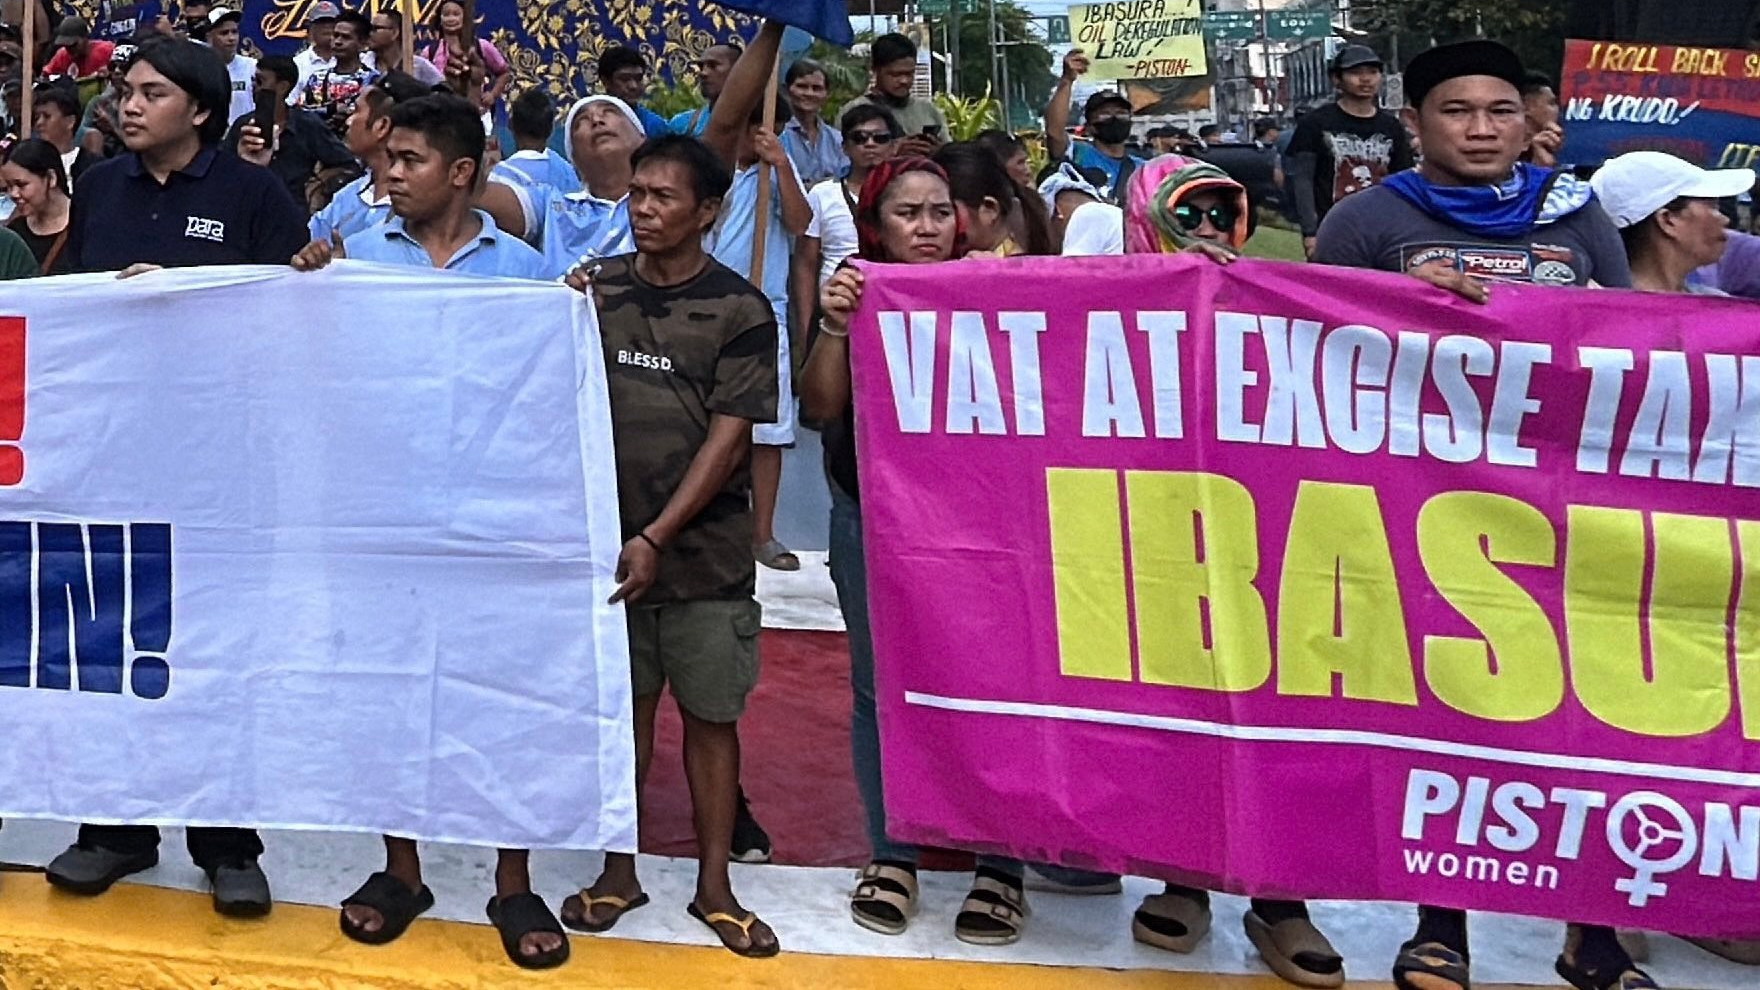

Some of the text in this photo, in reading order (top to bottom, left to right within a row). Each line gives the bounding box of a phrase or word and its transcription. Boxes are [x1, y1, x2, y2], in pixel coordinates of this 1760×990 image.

[1078, 23, 1107, 43] OIL
[1670, 47, 1728, 76] BACK
[1565, 96, 1593, 121] NG
[1469, 256, 1527, 270] Petrol
[876, 309, 1760, 488] VAT AT EXCISE TAX
[1044, 465, 1760, 743] IBASU
[1404, 848, 1561, 892] women
